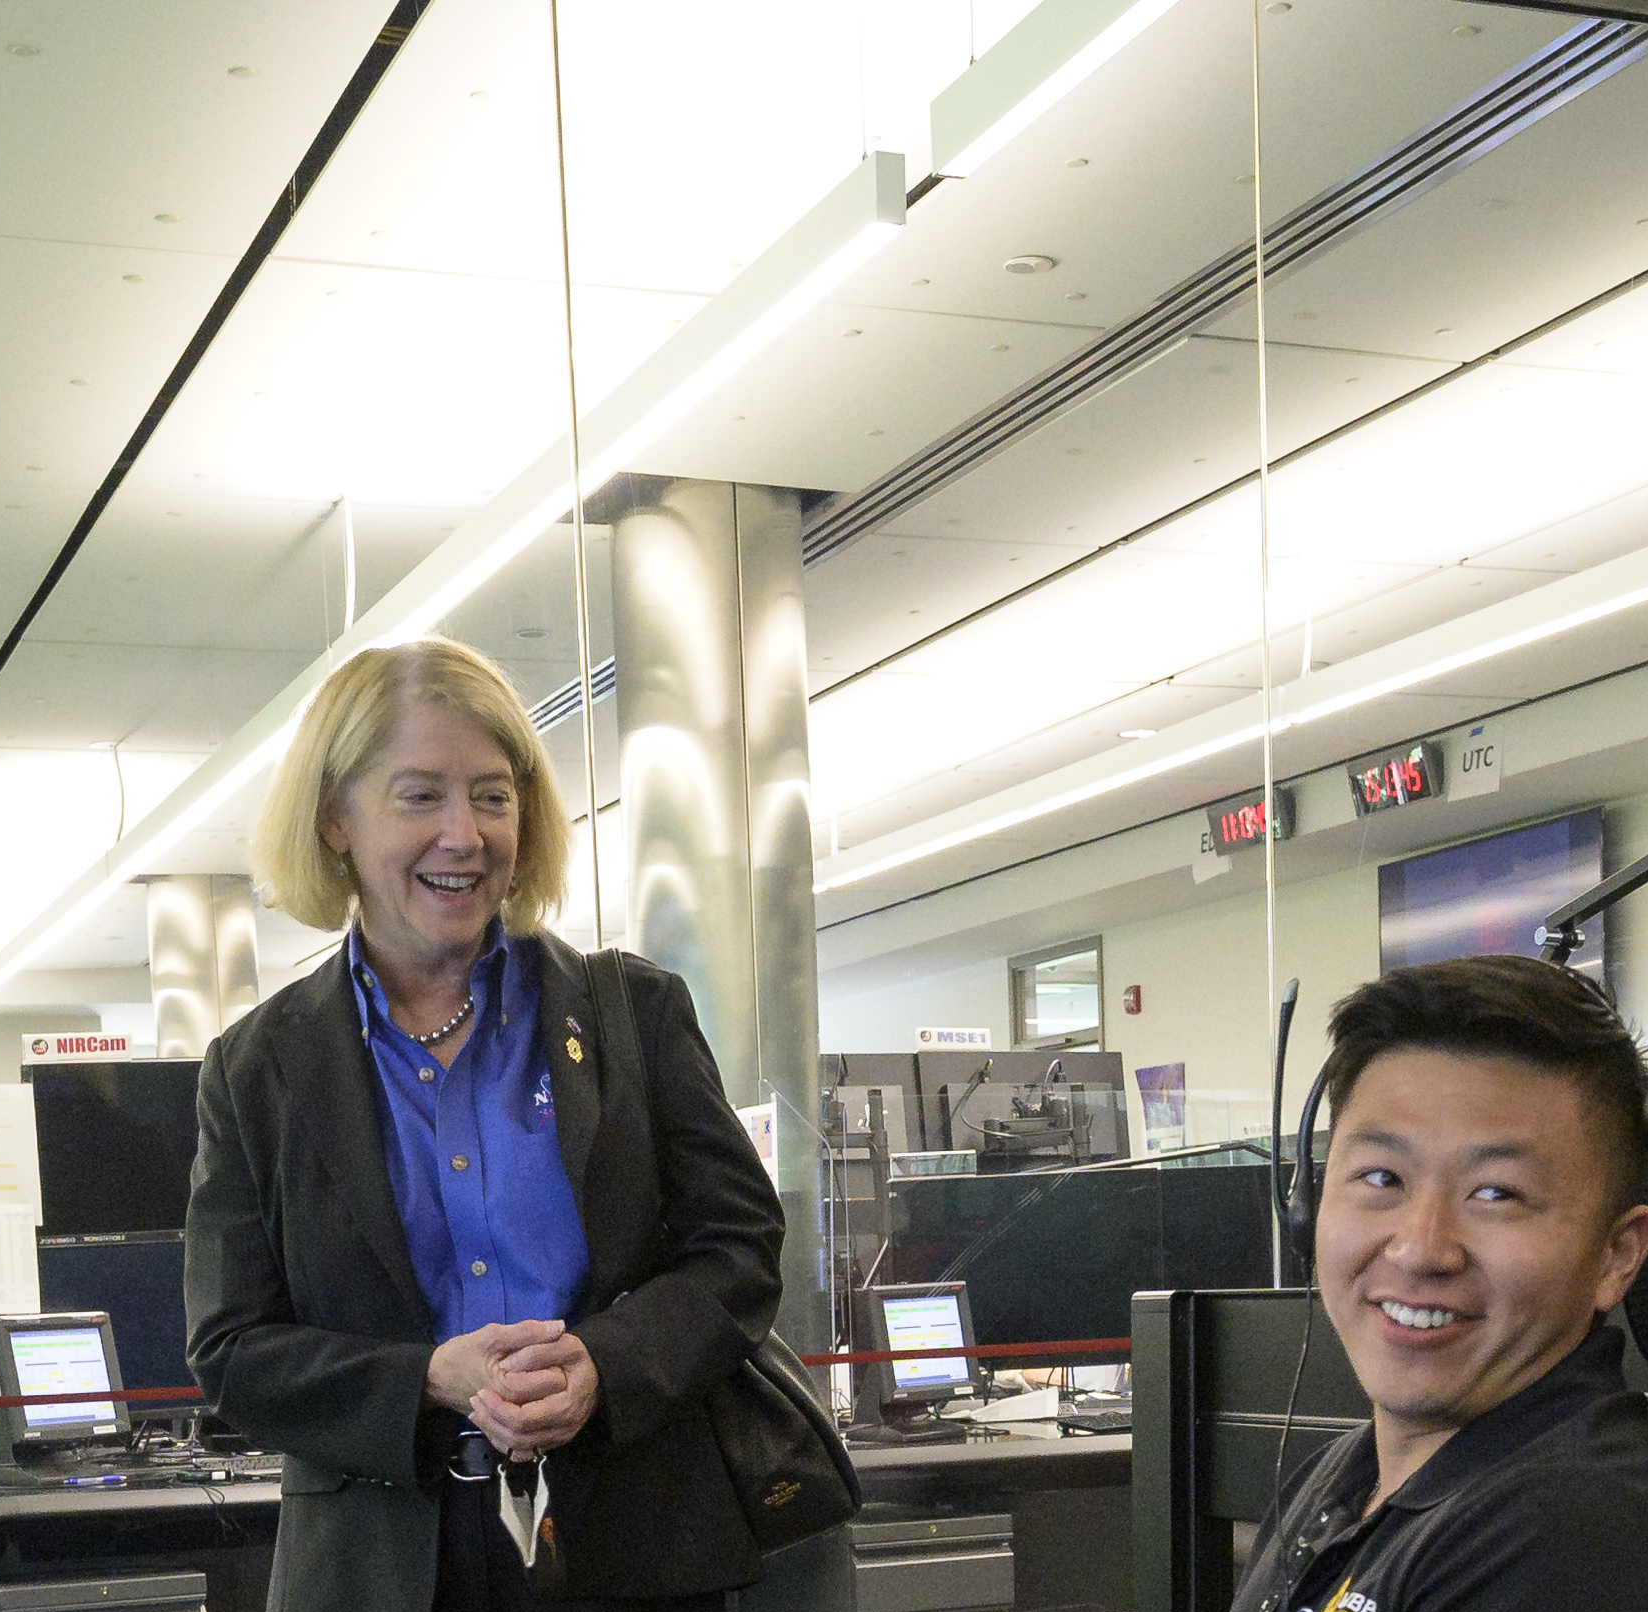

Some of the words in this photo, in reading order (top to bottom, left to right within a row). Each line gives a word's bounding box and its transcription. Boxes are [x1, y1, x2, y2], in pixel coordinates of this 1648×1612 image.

[1462, 746, 1495, 773] UTC
[56, 1037, 126, 1054] NIRCam
[937, 1032, 986, 1043] MSE1
[764, 1482, 802, 1505] COACH
